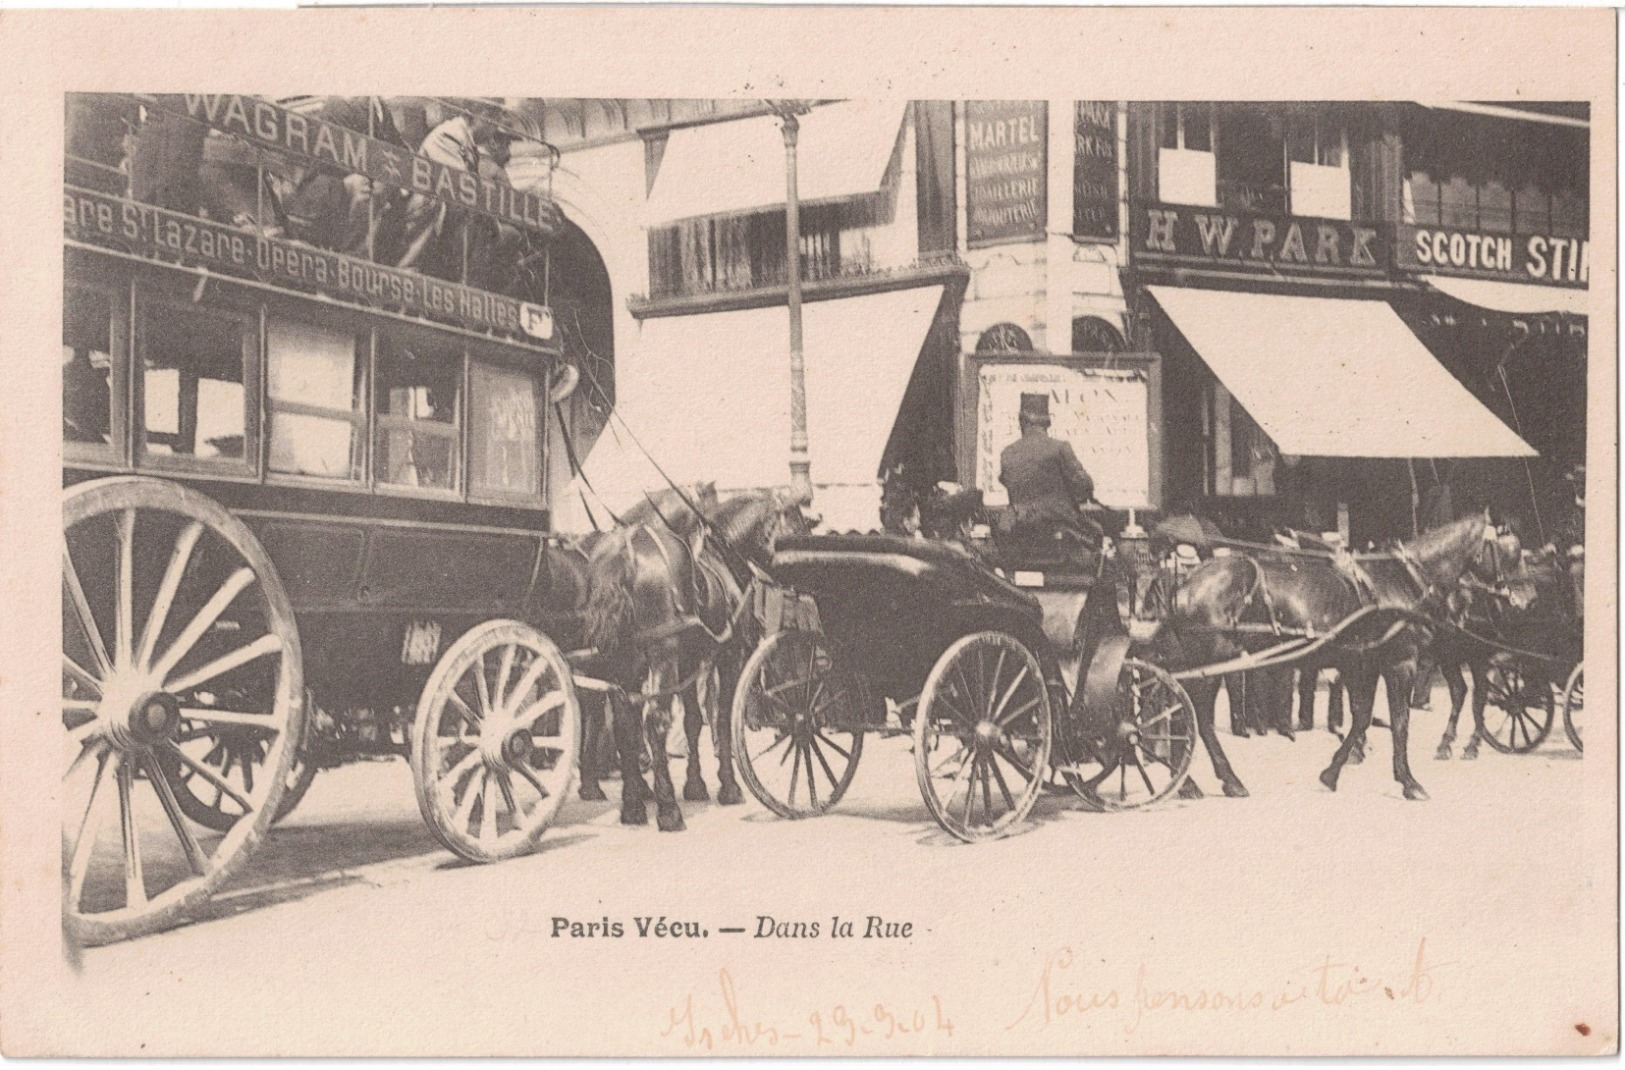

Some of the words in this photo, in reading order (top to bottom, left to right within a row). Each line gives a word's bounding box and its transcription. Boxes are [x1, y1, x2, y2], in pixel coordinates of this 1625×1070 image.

[184, 94, 368, 173] WAGRAM
[970, 115, 1039, 151] MARTEL
[1250, 218, 1377, 266] PARK
[1416, 229, 1512, 270] SCOTCH
